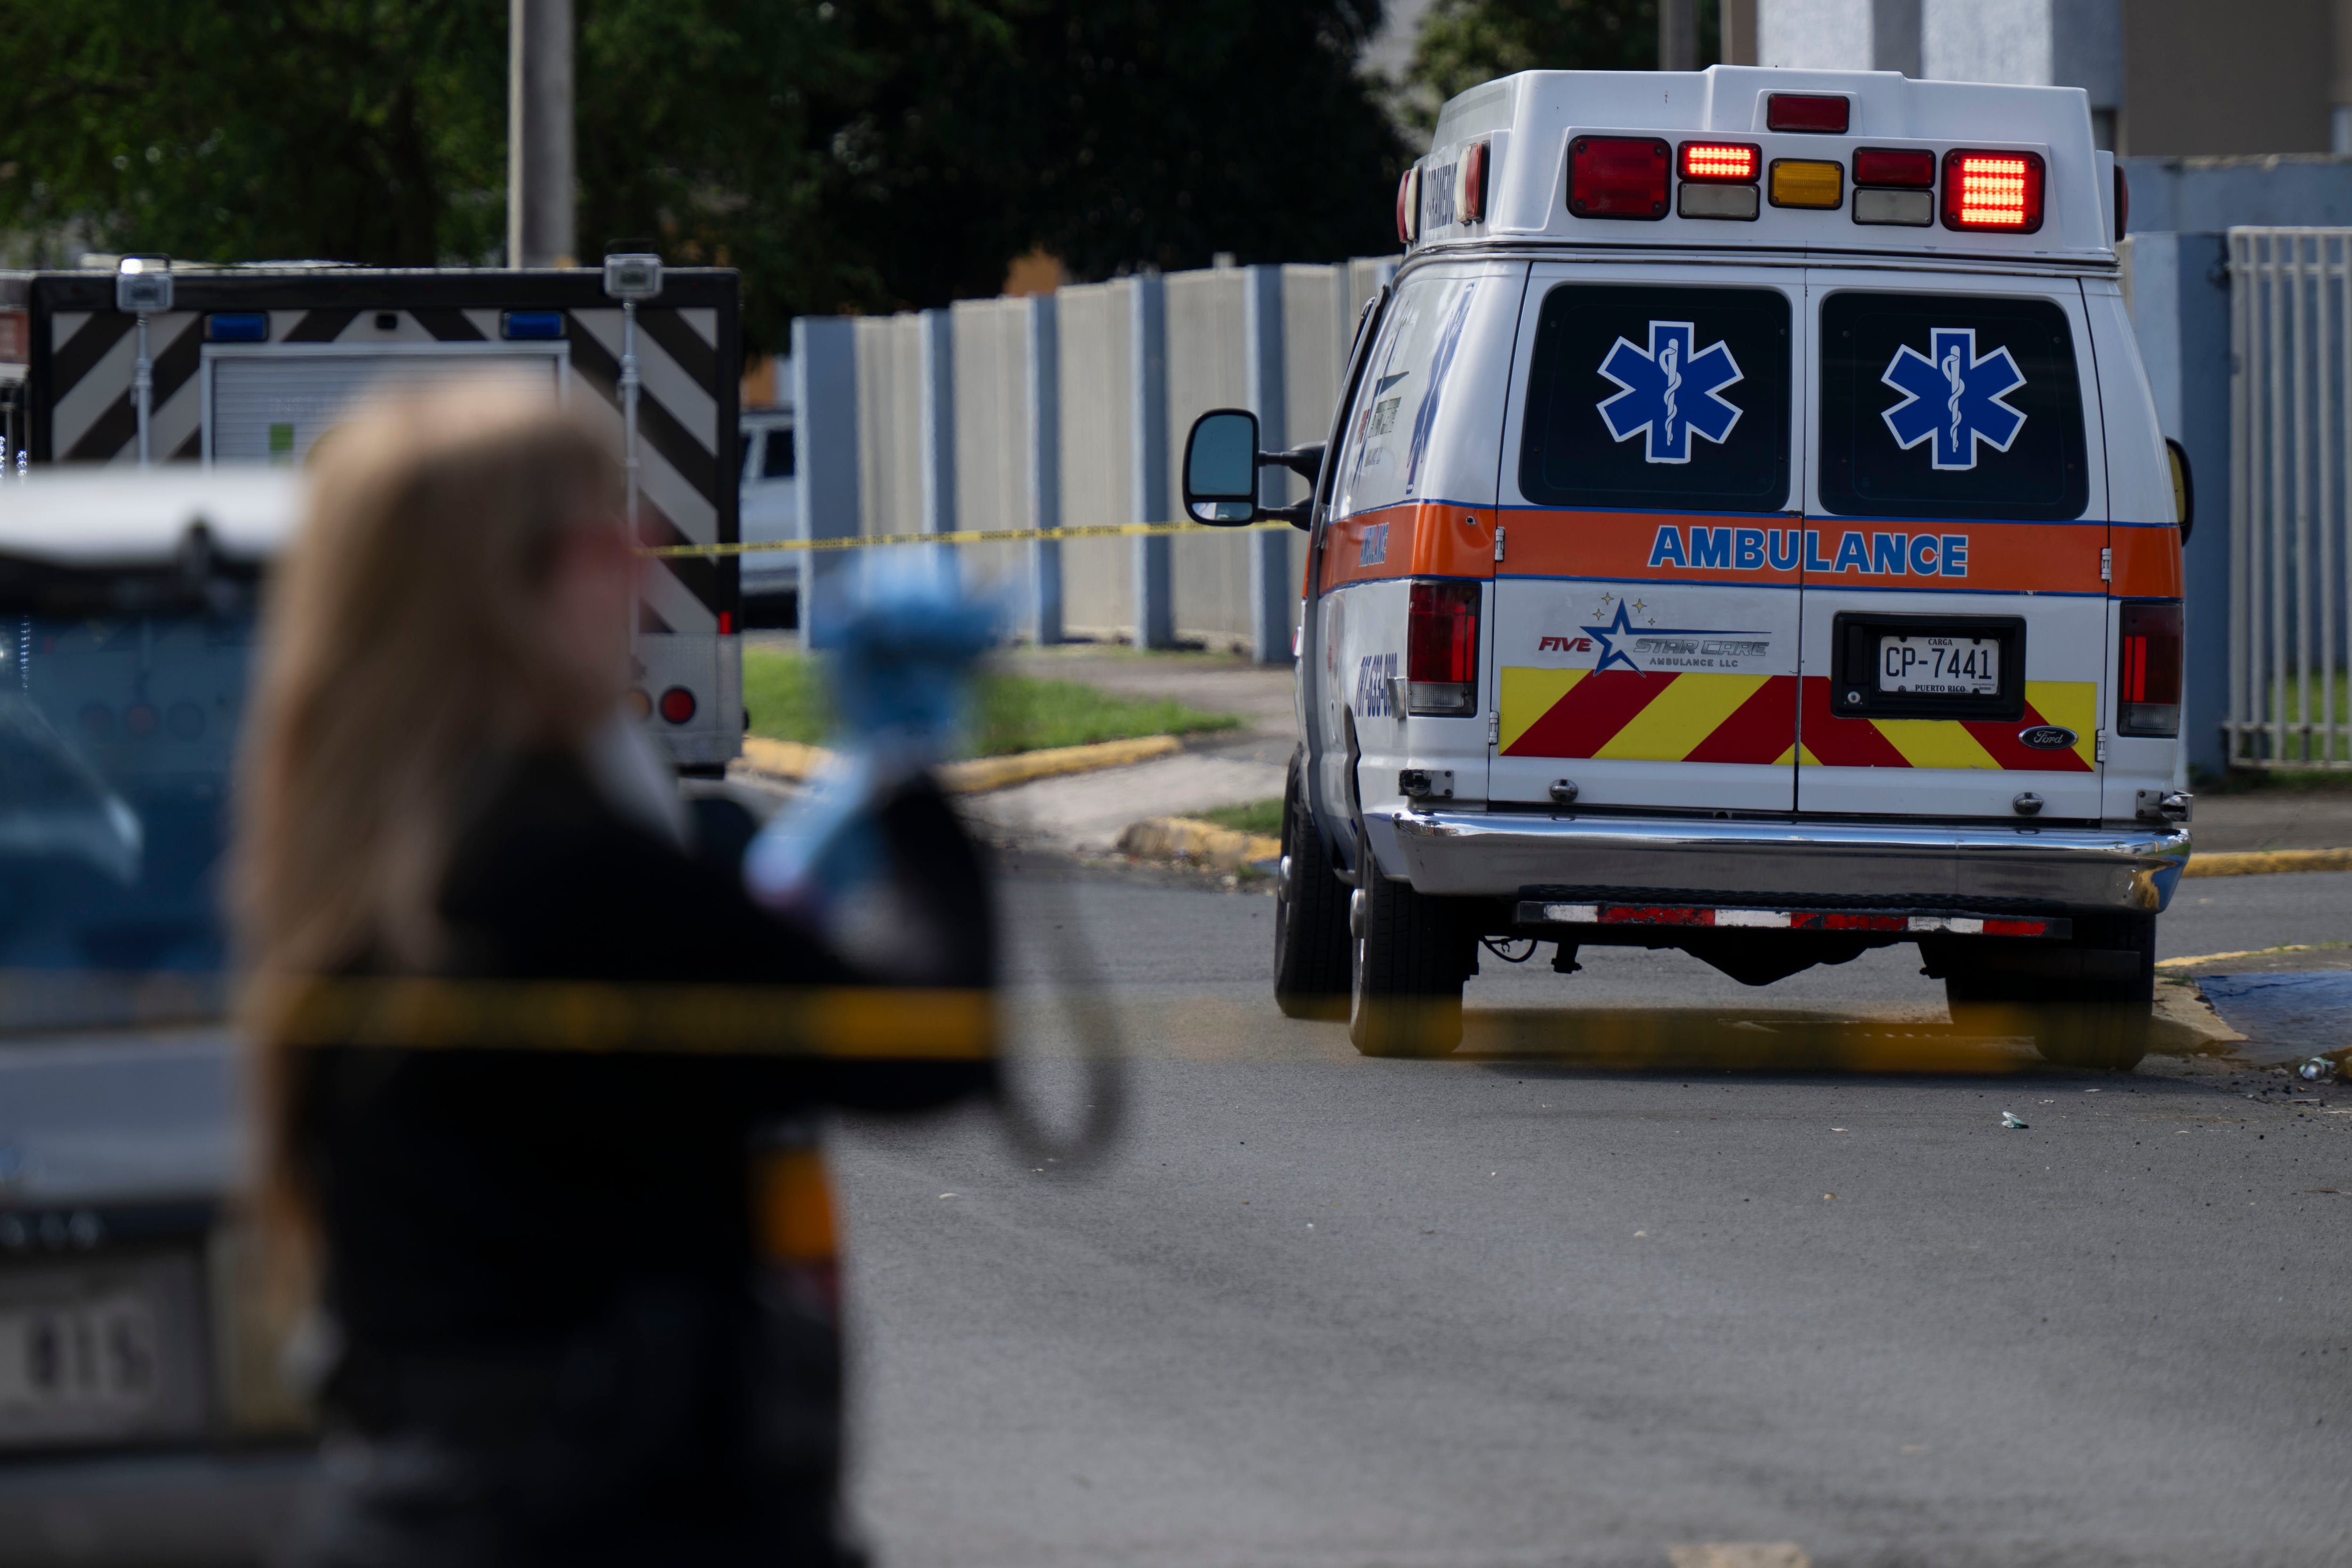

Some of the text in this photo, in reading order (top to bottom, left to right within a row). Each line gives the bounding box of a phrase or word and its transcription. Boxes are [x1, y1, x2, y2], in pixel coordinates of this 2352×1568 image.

[1647, 525, 1968, 576] AMBULANCE
[1539, 637, 1770, 656] FIVE STAR CARE
[1650, 658, 1713, 667] AMBULANCE
[1886, 647, 1992, 679] CP-7441
[2034, 731, 2064, 743] Ford
